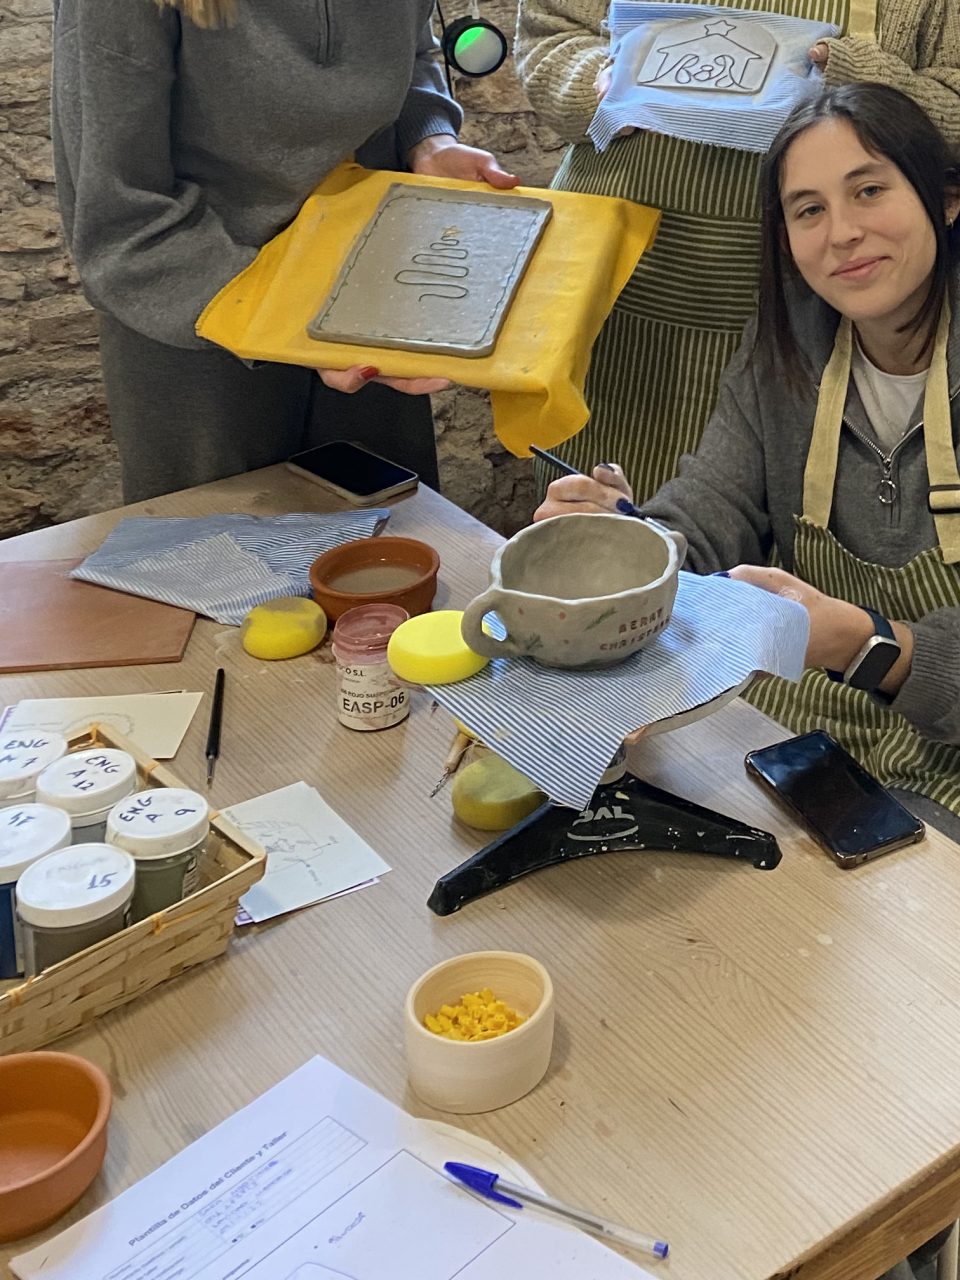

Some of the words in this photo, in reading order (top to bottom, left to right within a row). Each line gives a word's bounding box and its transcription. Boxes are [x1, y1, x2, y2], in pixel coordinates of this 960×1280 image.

[343, 691, 405, 714] EASP-06
[4, 738, 49, 750] ENG
[86, 755, 119, 774] ENG
[66, 769, 88, 779] A
[73, 779, 95, 791] 12
[119, 796, 153, 822] ENG
[86, 872, 118, 890] 15
[128, 1219, 168, 1246] Plantilla
[167, 1208, 181, 1220] de
[180, 1188, 209, 1210] Datos
[209, 1177, 224, 1191] del
[224, 1156, 256, 1179] Cliente
[262, 1131, 288, 1150] Taller
